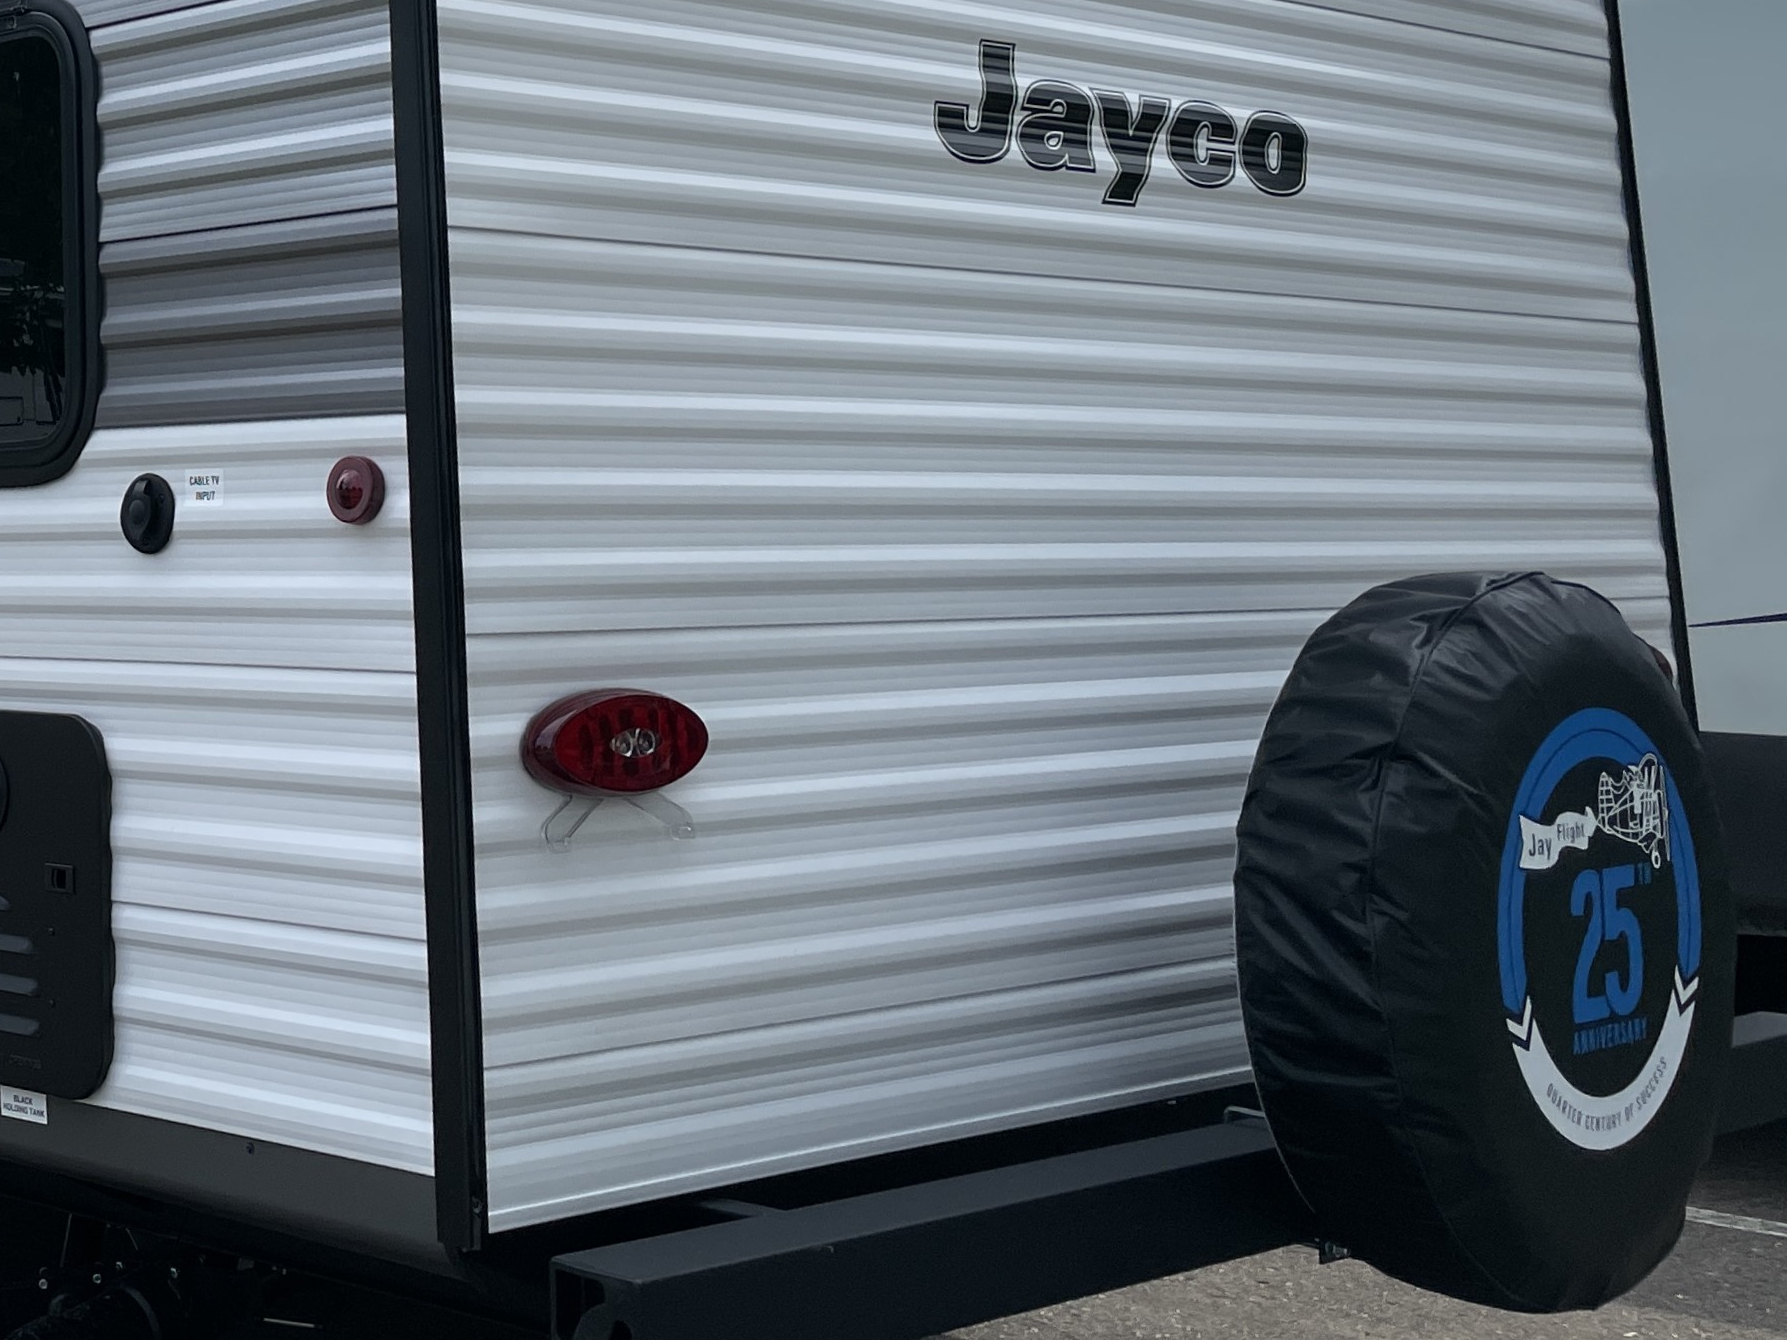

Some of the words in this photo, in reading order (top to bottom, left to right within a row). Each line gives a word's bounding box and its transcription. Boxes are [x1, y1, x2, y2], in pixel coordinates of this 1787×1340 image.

[933, 38, 1309, 208] Jayco
[189, 475, 210, 486] CABLE
[211, 475, 220, 486] TV
[195, 490, 216, 501] INPUT
[1528, 833, 1552, 861] Jay
[1556, 821, 1586, 844] Flight
[1573, 1017, 1647, 1056] ANNIVERSARY
[13, 1094, 33, 1106] BLACK
[1546, 1082, 1582, 1126] QUARTER
[1585, 1111, 1622, 1132] CENTURY
[1624, 1102, 1634, 1122] OF
[1635, 1056, 1667, 1111] SUCCESS
[28, 1107, 45, 1117] TANK
